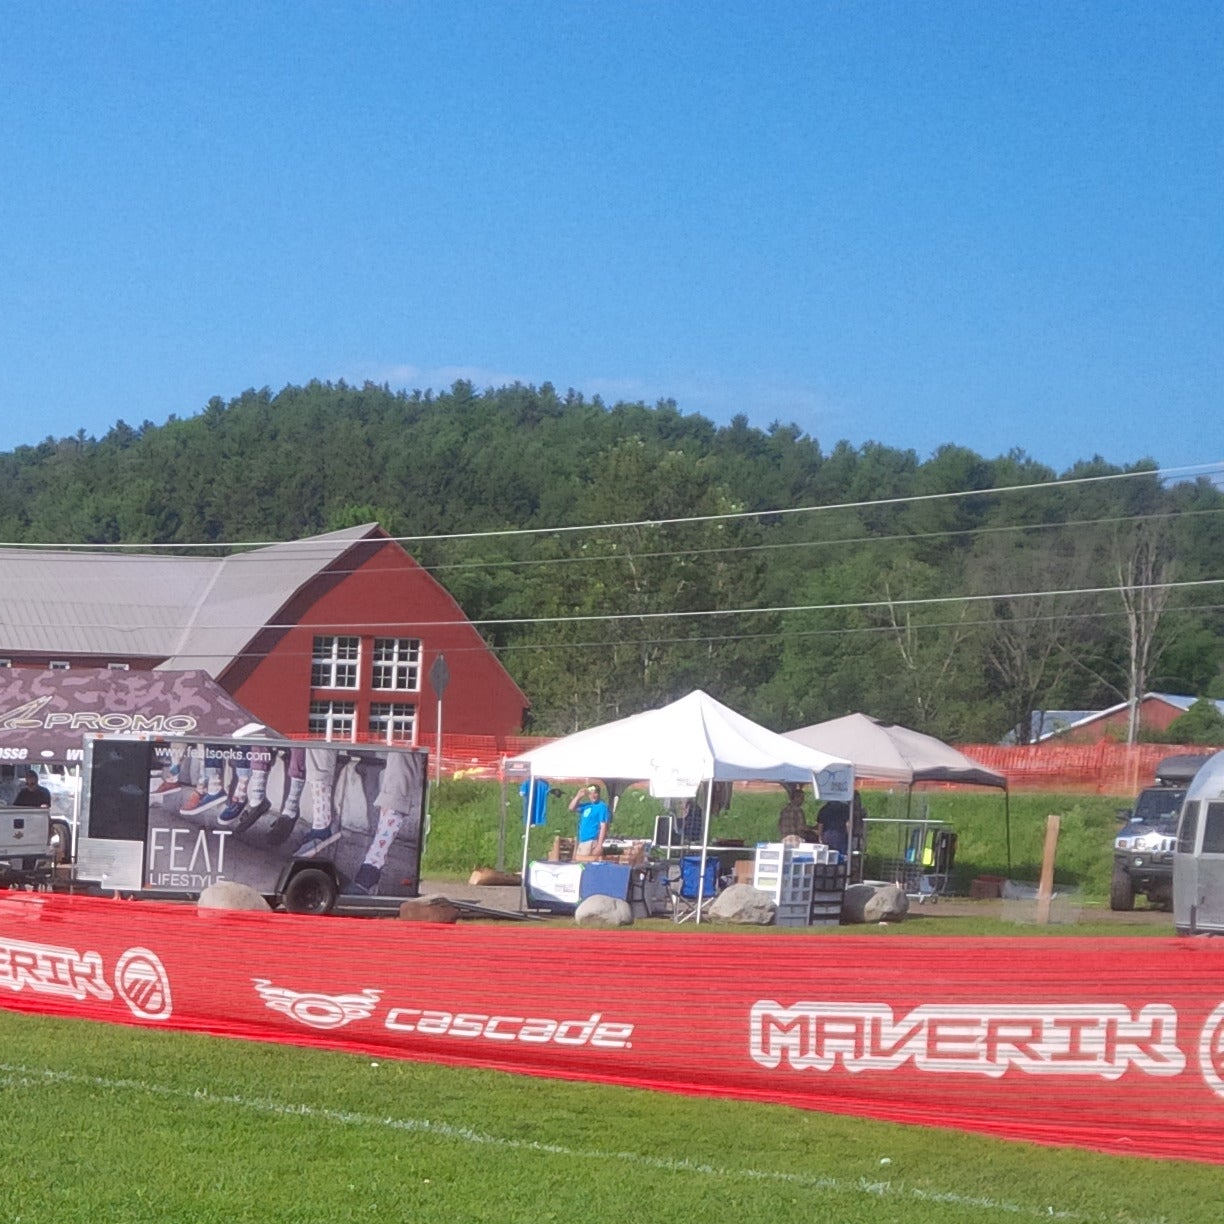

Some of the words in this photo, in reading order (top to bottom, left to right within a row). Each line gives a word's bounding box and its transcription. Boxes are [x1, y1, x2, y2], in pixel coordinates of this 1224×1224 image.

[44, 713, 196, 731] PROMO
[149, 828, 233, 873] FEAT
[384, 1012, 635, 1049] cascade
[752, 1002, 1184, 1077] MAVERIK
